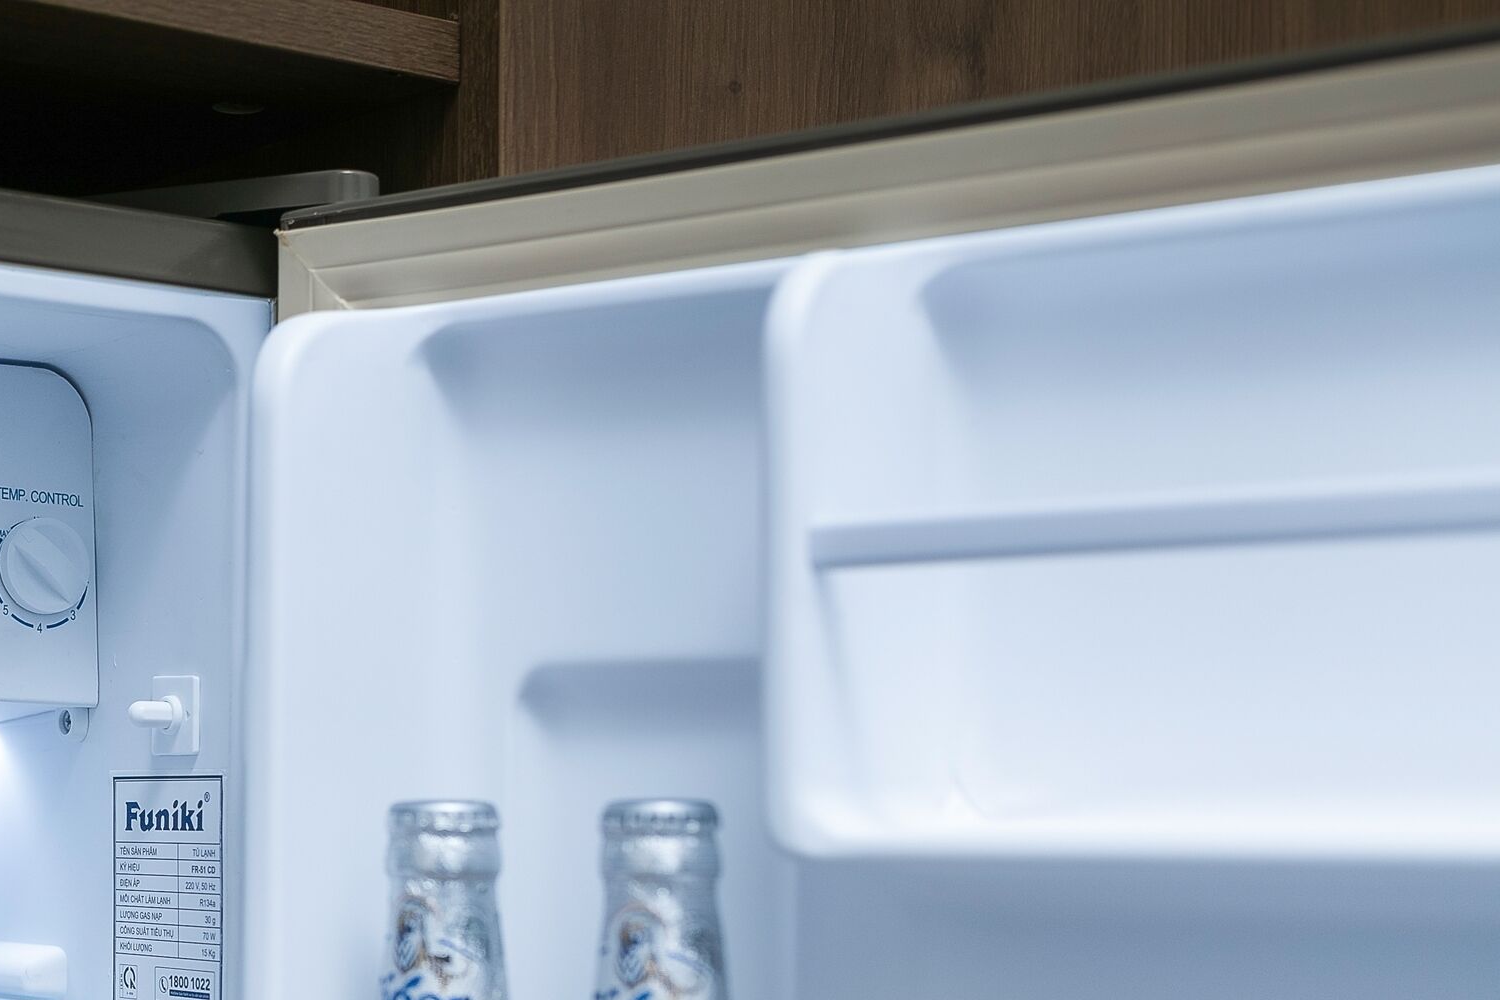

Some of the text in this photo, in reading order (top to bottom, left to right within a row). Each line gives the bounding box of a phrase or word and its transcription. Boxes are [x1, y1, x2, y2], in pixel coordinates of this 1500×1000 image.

[31, 490, 84, 507] CONTROL
[3, 605, 9, 616] 5
[70, 610, 76, 620] 3
[37, 624, 43, 634] 4
[125, 800, 204, 831] Funiki
[186, 882, 194, 890] 220
[209, 883, 215, 891] Hz
[200, 899, 215, 907] R134a
[203, 932, 210, 940] 70
[202, 949, 216, 959] 15 Kg
[169, 975, 210, 991] 1800 1022
